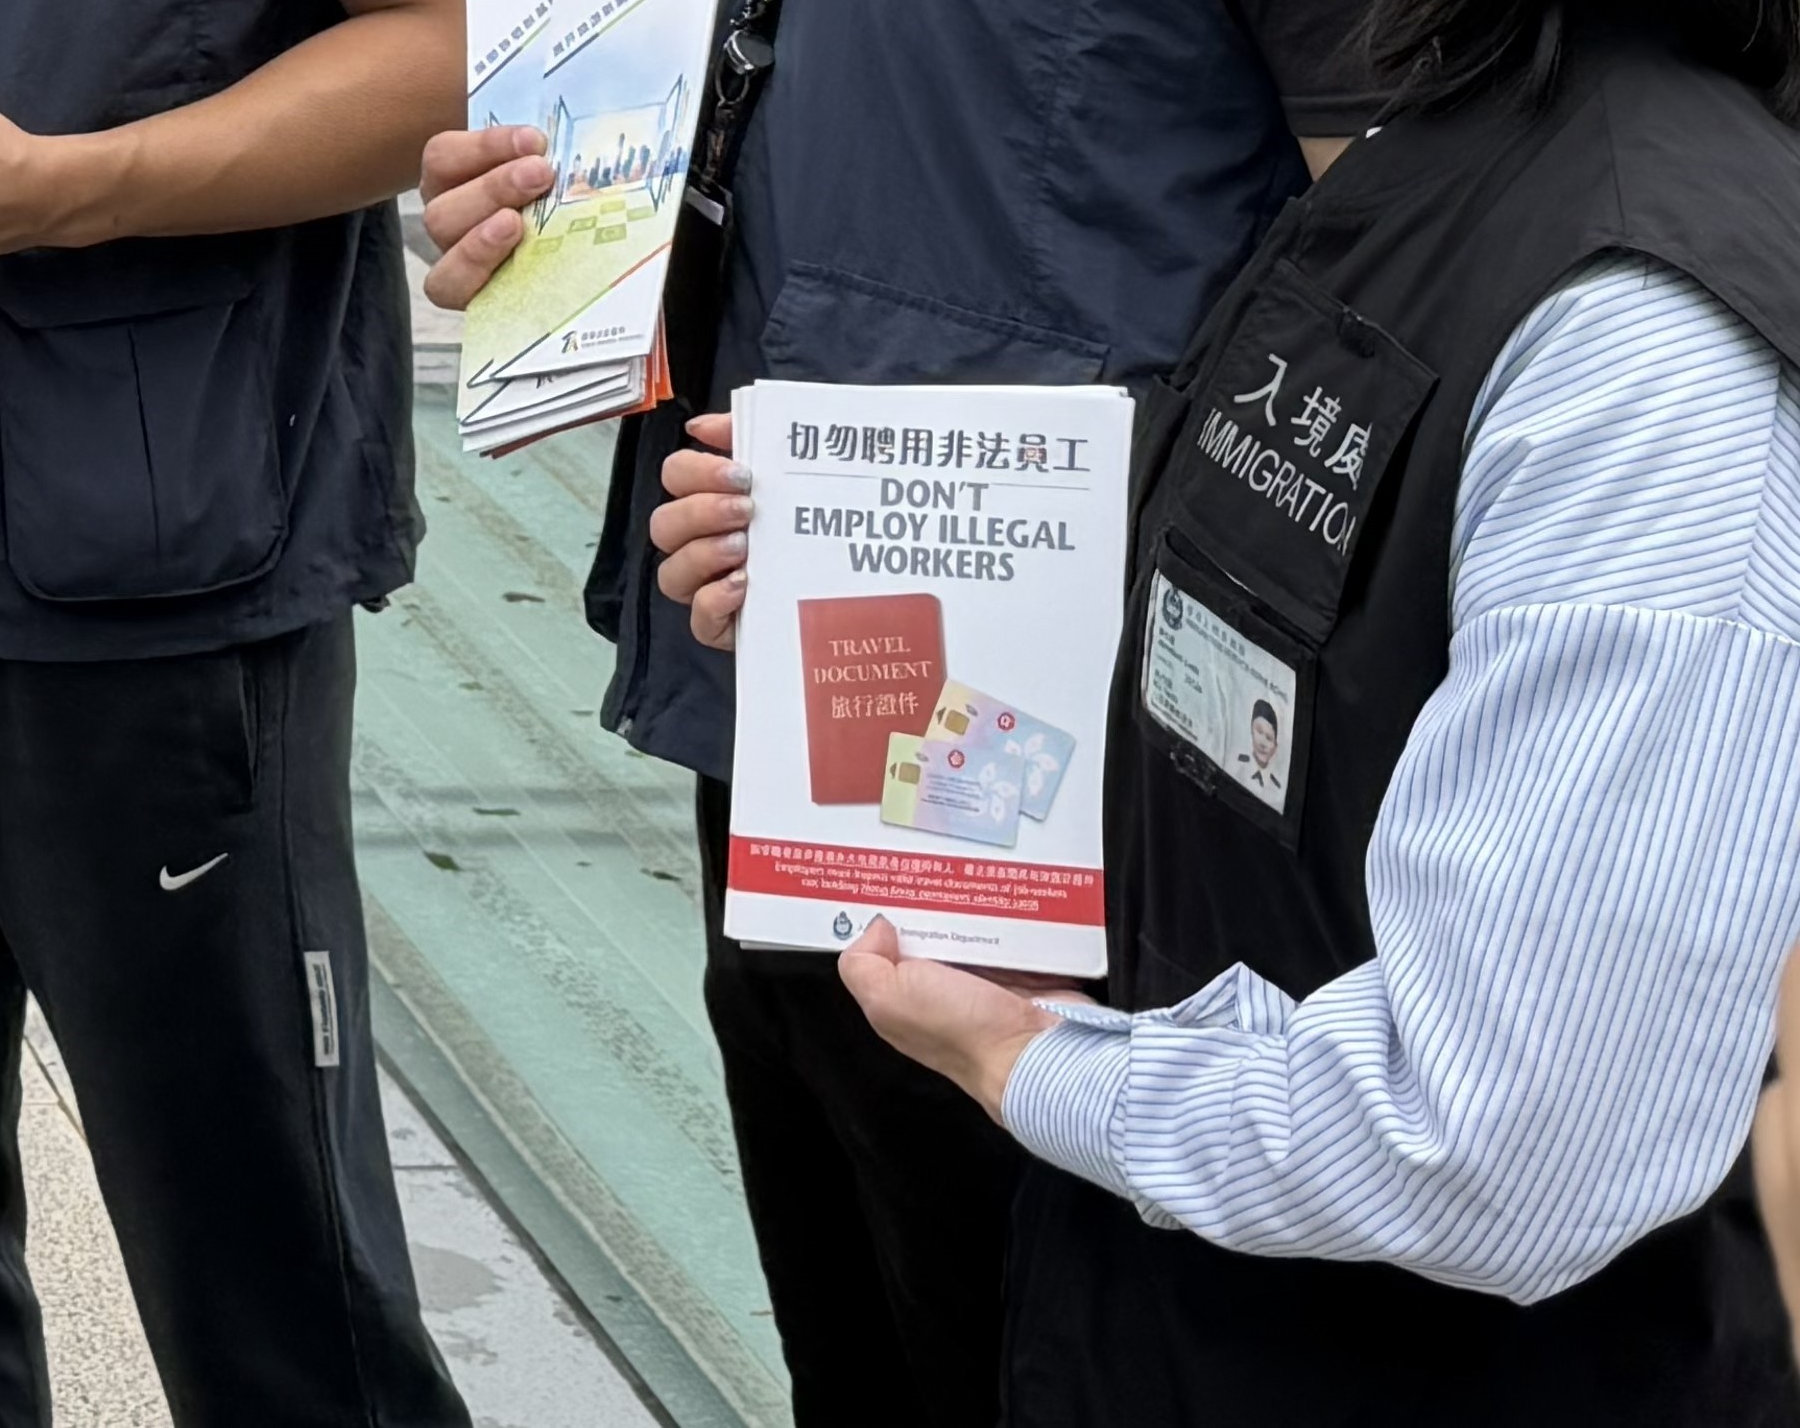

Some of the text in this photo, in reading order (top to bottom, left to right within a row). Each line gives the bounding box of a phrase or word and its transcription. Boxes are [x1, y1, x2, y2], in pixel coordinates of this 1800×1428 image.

[787, 421, 1091, 473] 切勿聘用非法員工
[880, 478, 989, 511] DON'T
[794, 506, 1076, 551] EMPLOY ILLEGAL
[849, 542, 1015, 581] WORKERS
[828, 636, 911, 657] TRAVEL
[813, 661, 933, 684] DOCUMENT
